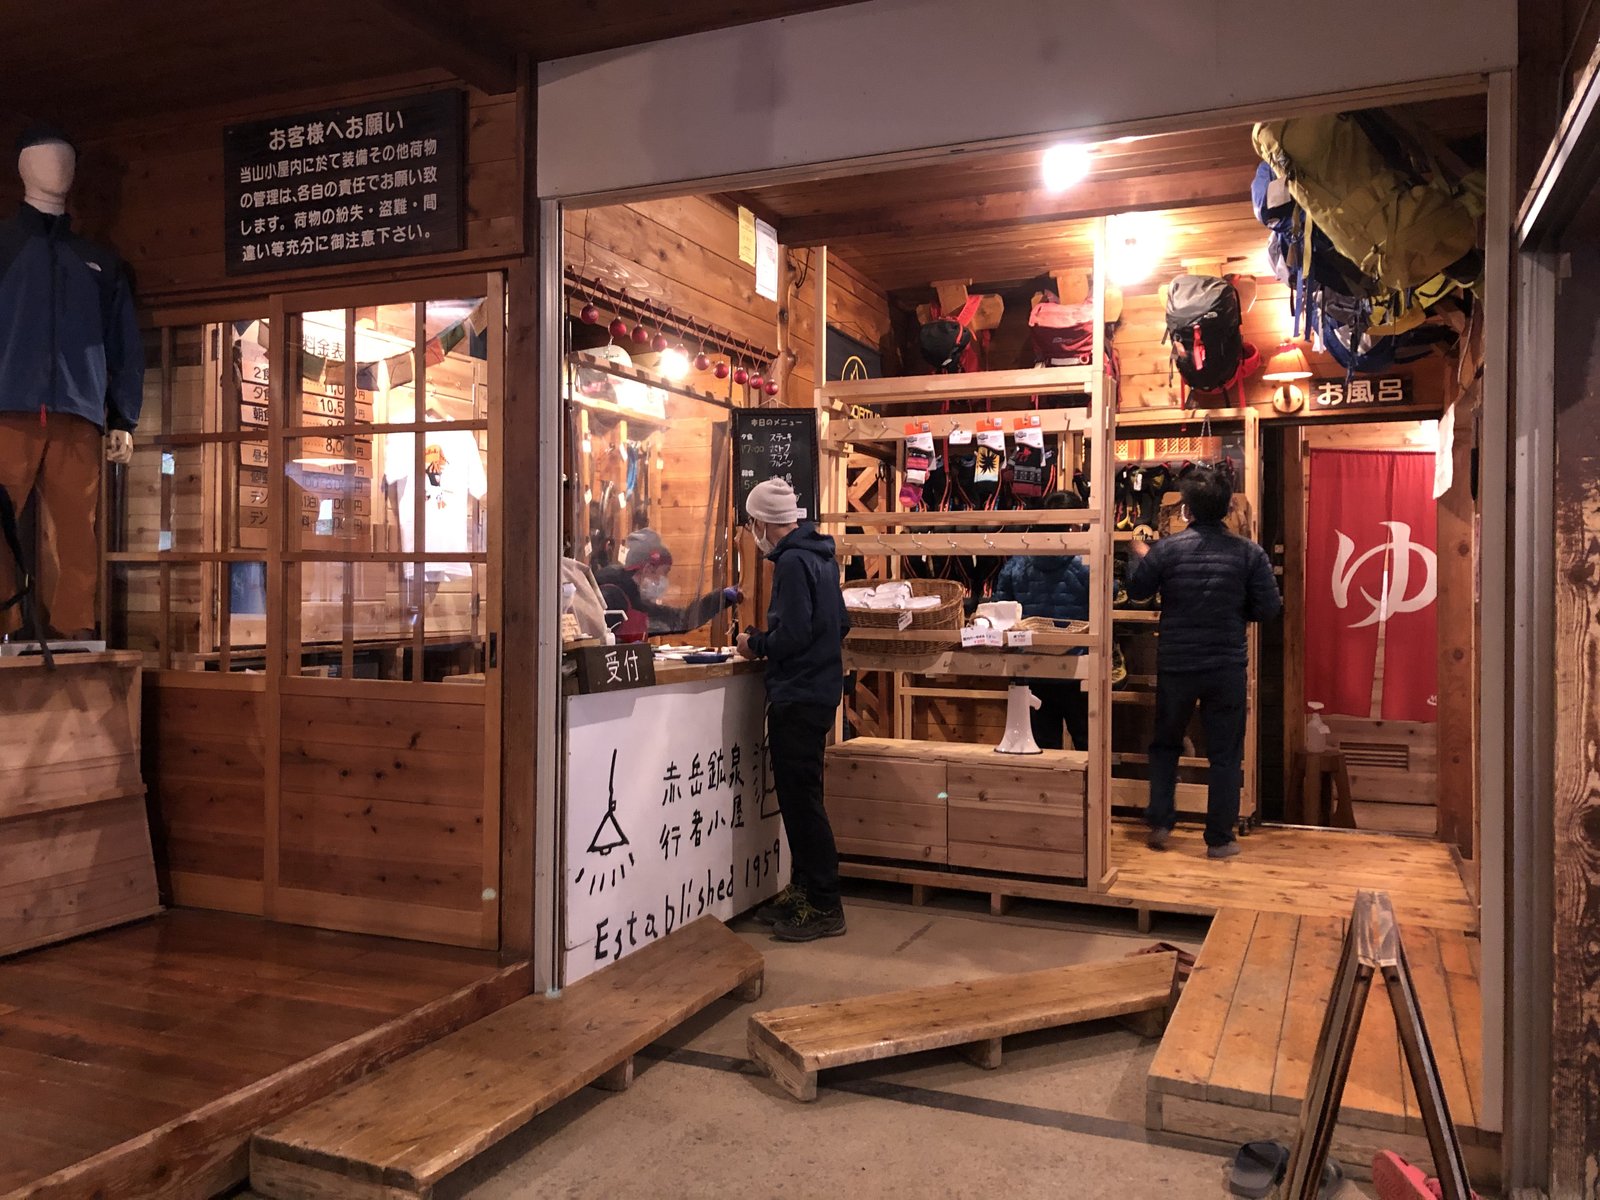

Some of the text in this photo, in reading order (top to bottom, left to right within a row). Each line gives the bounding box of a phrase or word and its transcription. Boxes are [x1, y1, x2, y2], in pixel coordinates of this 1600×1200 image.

[269, 110, 404, 151] お客様へお願い
[240, 138, 438, 184] 当山小屋内に於て装備その他荷物
[240, 165, 438, 209] の管理は、各自の責任でお願い致
[1317, 379, 1403, 406] お風呂
[769, 432, 792, 442] ステーキ
[1331, 520, 1438, 629] ゆ
[604, 650, 640, 684] 受付
[661, 741, 745, 806] 赤岳鉱泉
[659, 794, 745, 860] 行者小屋
[594, 838, 780, 961] Established 1959
